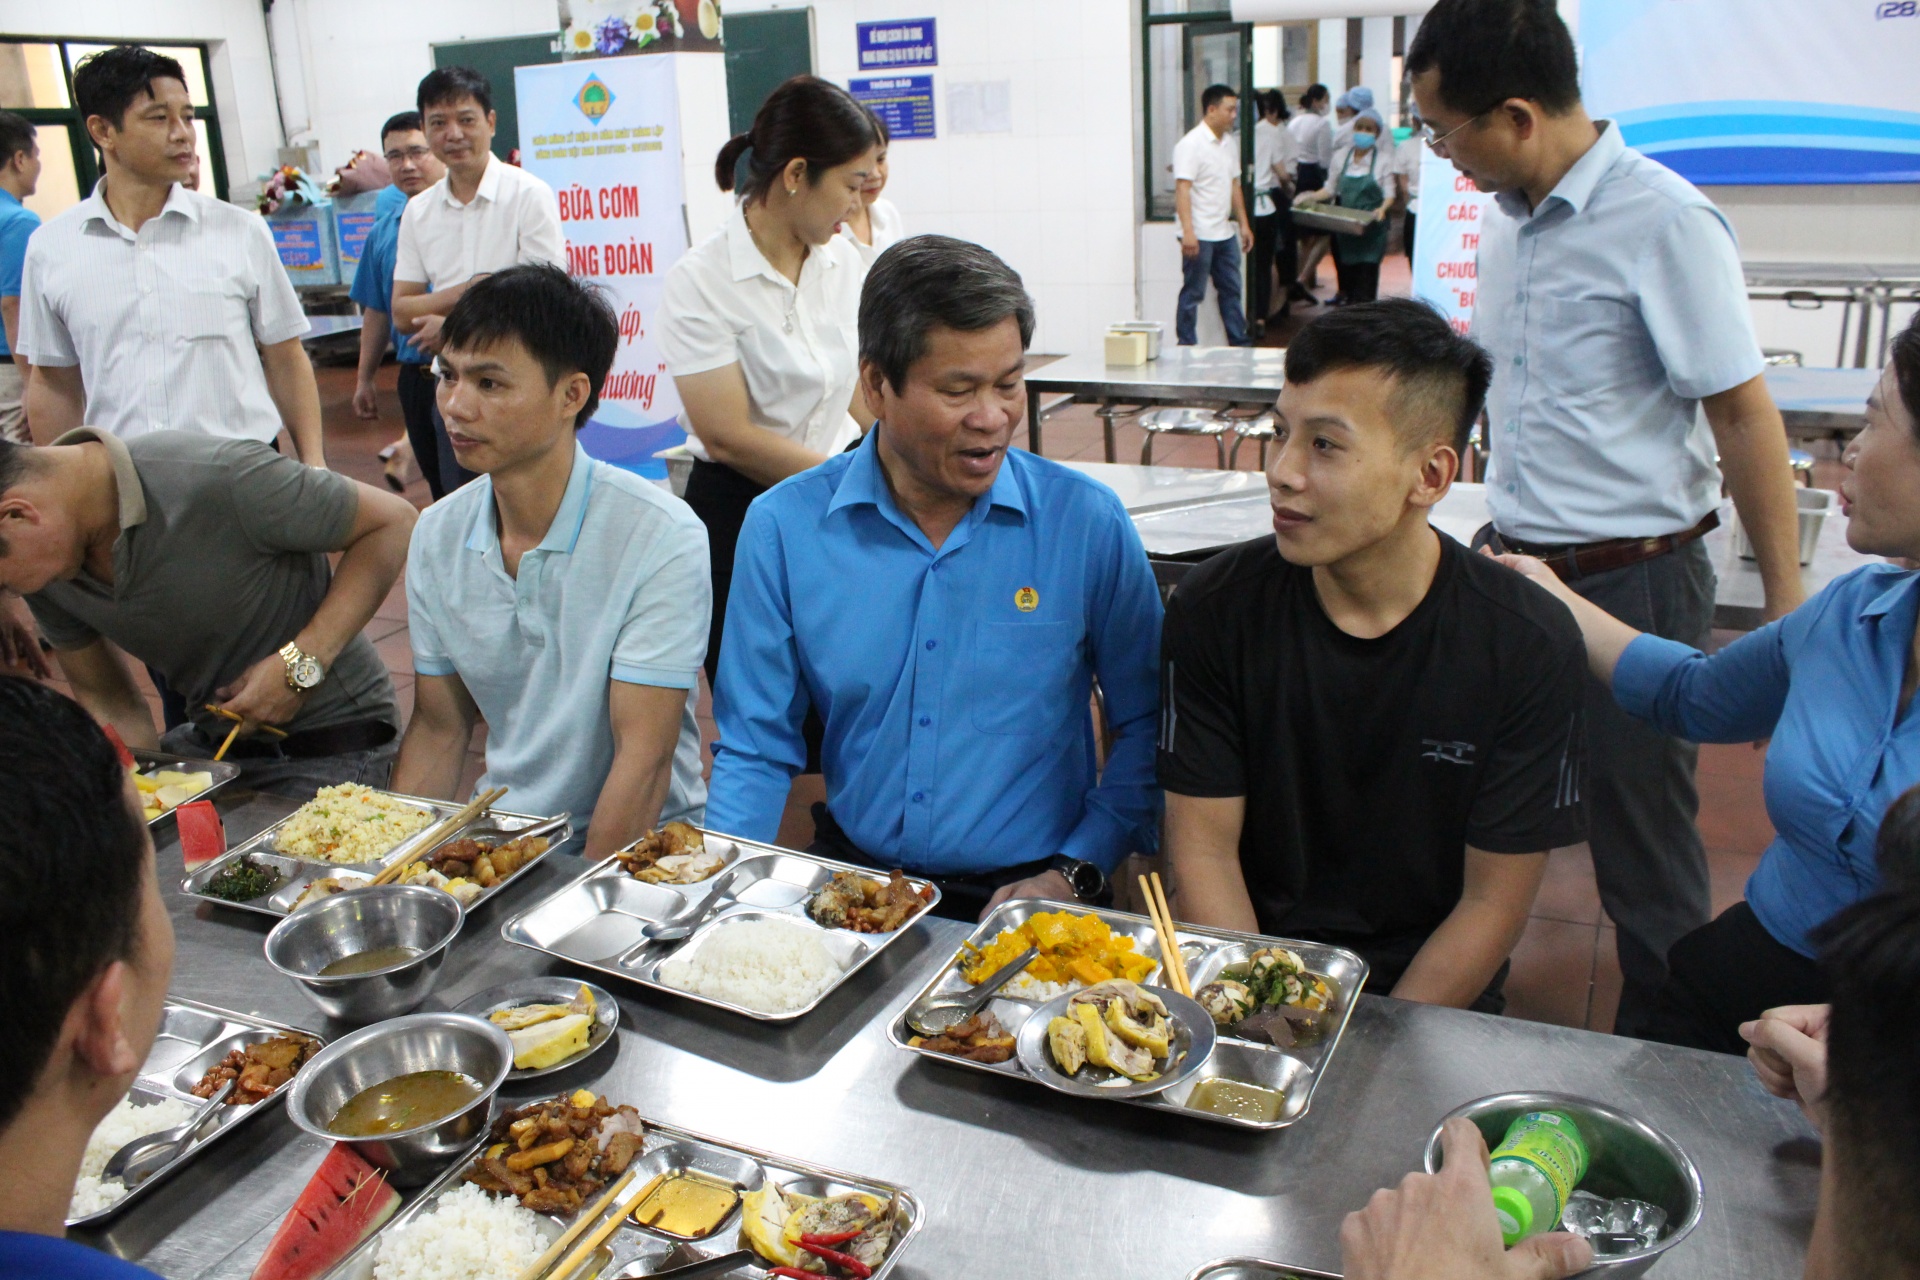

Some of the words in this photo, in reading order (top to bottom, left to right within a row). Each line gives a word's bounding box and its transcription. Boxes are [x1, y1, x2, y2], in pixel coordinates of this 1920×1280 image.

[559, 183, 594, 221] BỮA
[599, 183, 639, 219] CƠM
[1447, 201, 1478, 221] CÁC
[565, 239, 599, 278] ÔNG
[604, 236, 653, 275] ĐOÀN
[1462, 233, 1480, 250] TH
[620, 302, 645, 346] áp,
